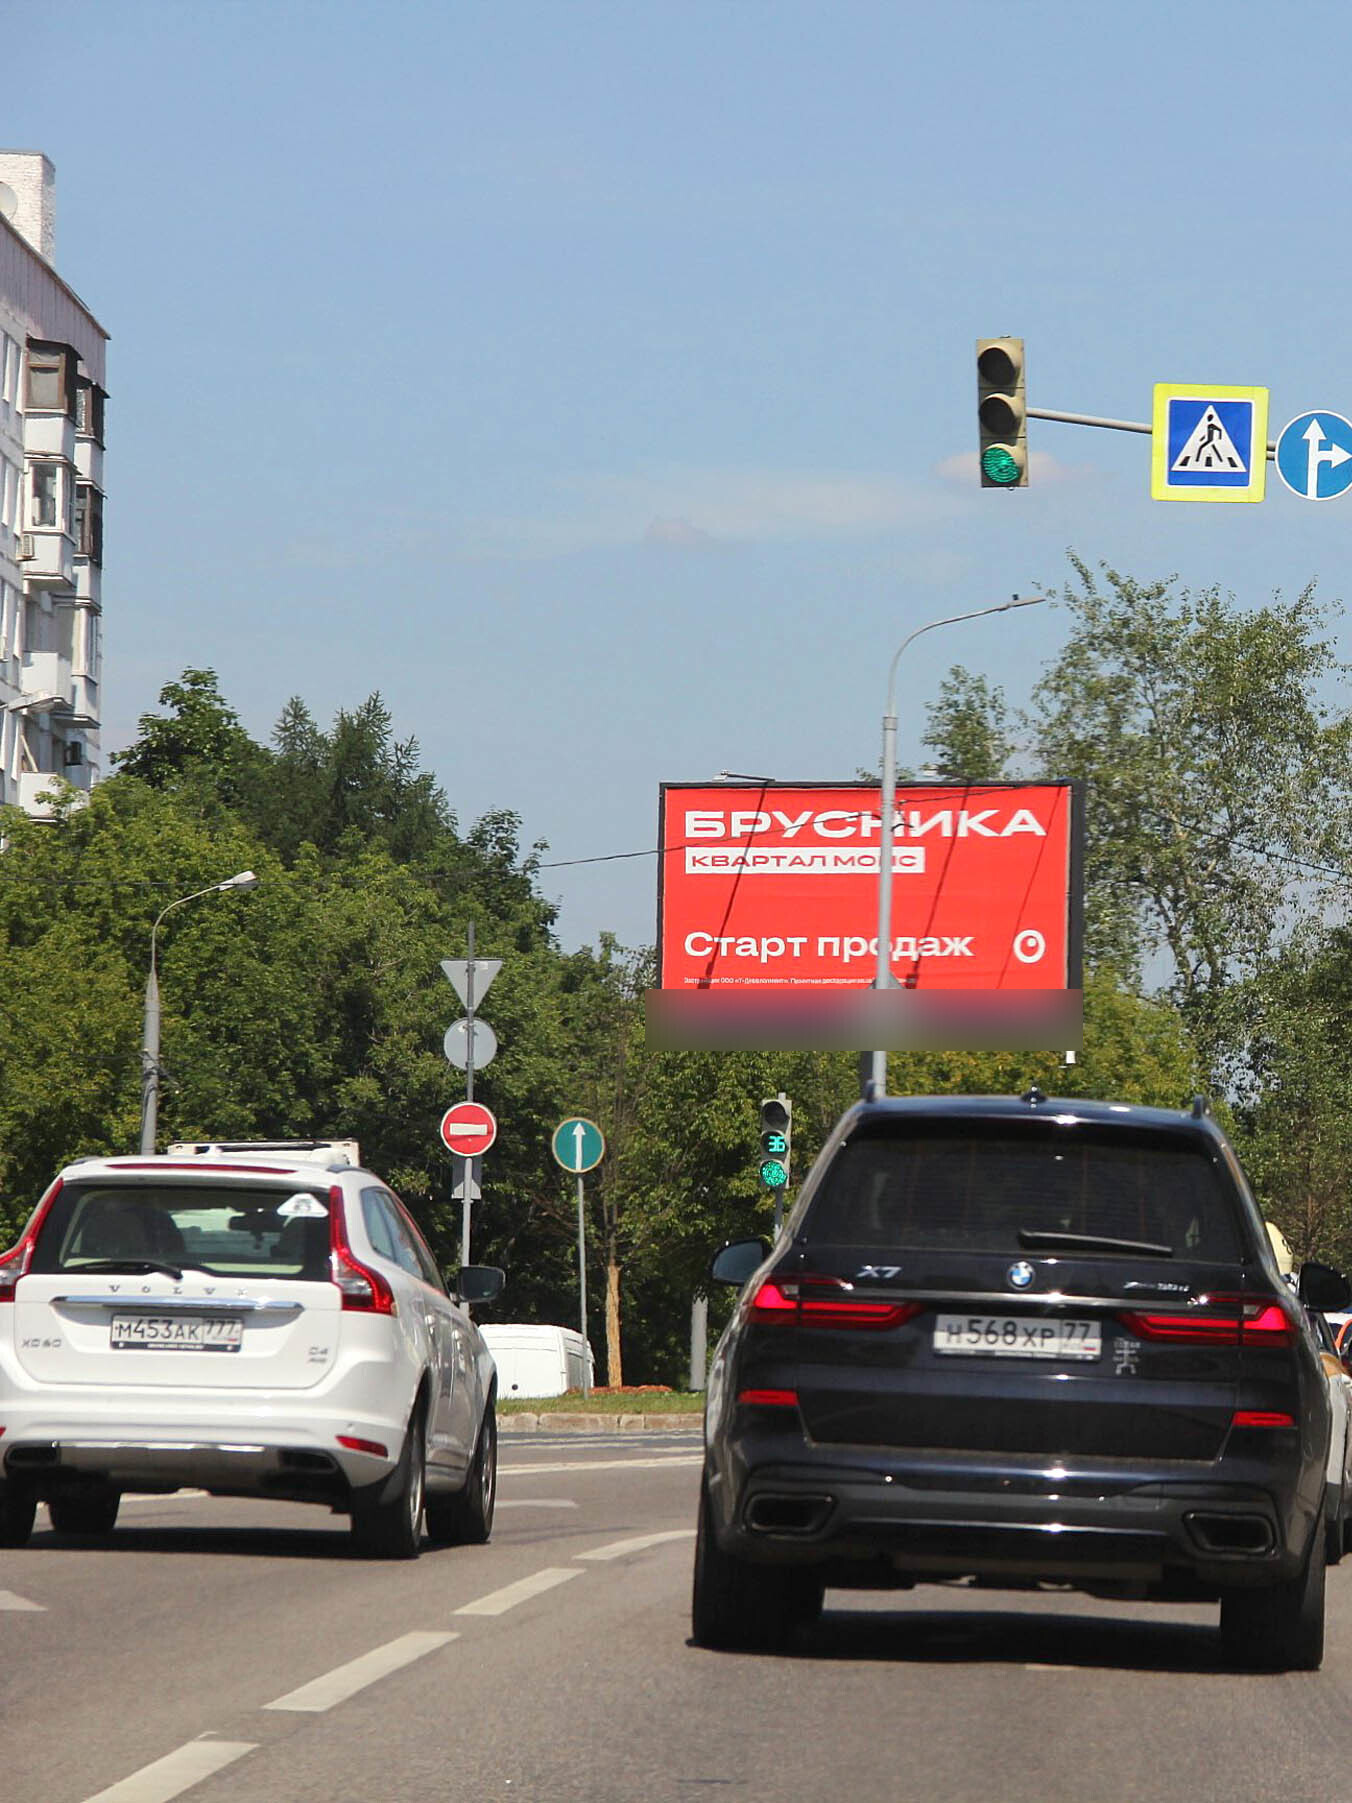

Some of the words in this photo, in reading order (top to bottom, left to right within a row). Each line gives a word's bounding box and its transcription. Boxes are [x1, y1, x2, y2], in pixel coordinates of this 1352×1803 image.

[684, 810, 1047, 839] БРУСНИКА
[691, 855, 826, 867] КВАРТАЛ
[684, 931, 808, 963] Старт
[817, 936, 977, 963] продаж
[768, 1135, 786, 1153] 36
[856, 1264, 903, 1278] X7
[1063, 1322, 1091, 1342] 77
